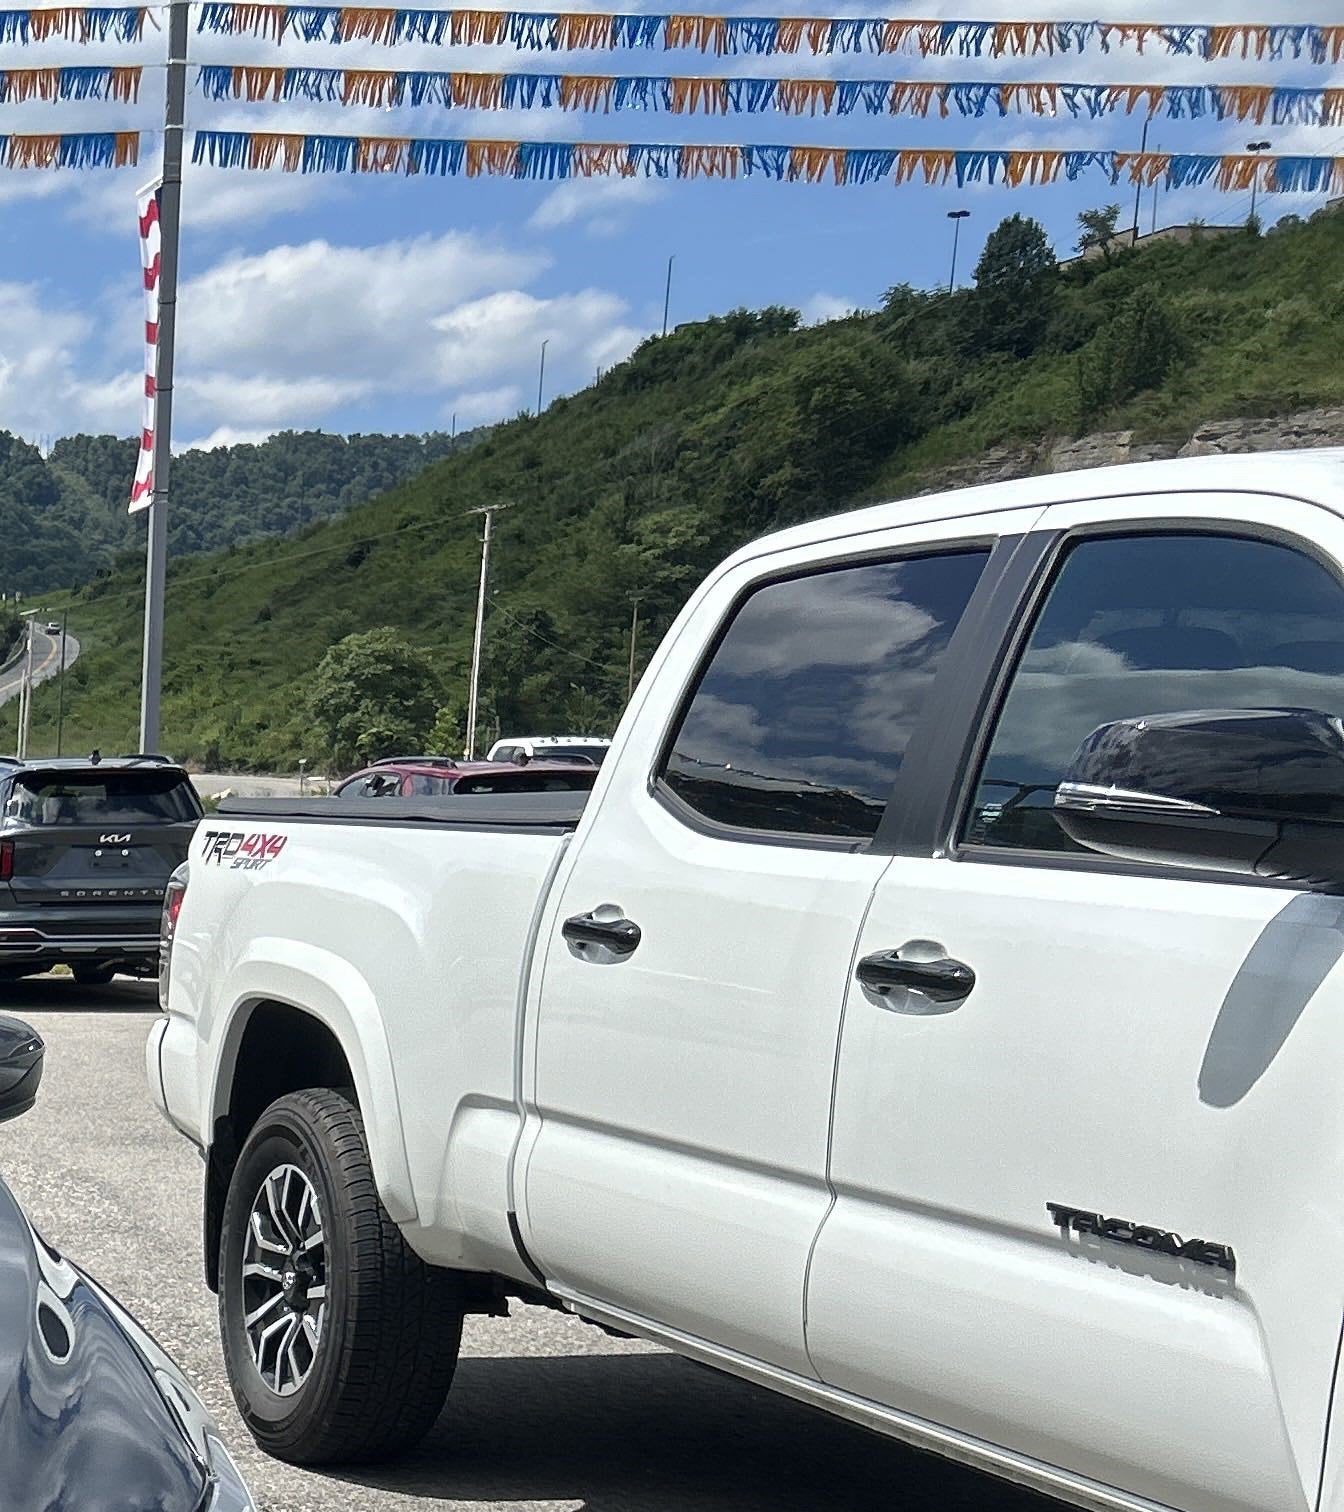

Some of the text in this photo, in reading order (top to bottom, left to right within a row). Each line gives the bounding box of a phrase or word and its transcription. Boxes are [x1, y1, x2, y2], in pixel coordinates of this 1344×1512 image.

[99, 833, 132, 843] KIA
[201, 830, 245, 866] TRD
[230, 857, 273, 871] SPORT
[60, 889, 165, 897] SORENTO
[1045, 1201, 1237, 1272] TACOMA
